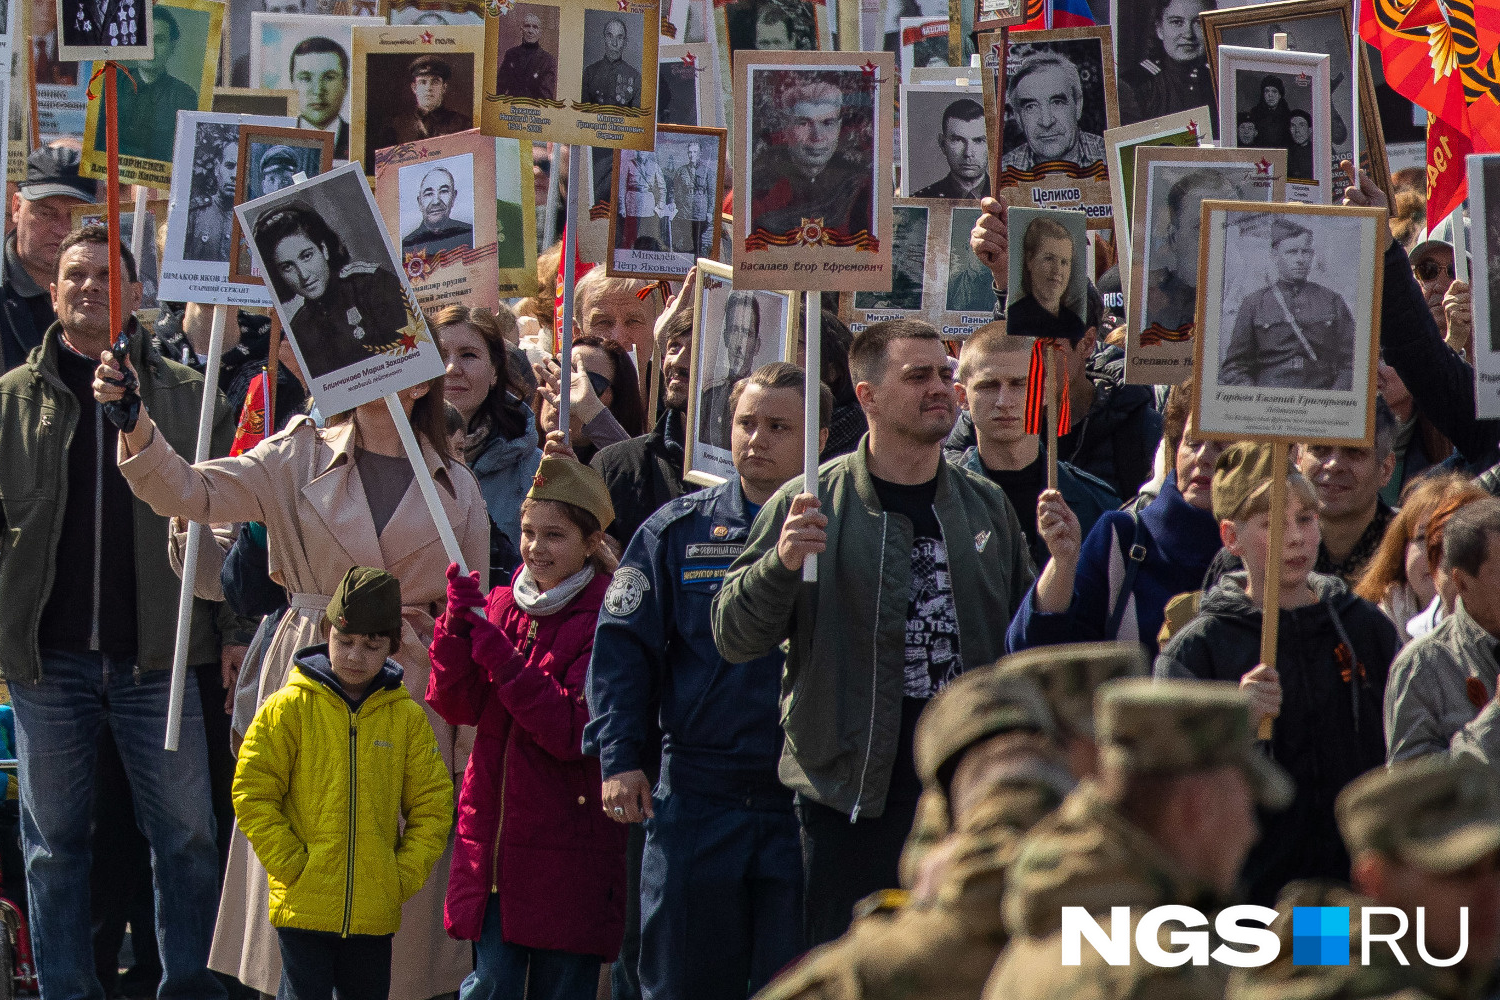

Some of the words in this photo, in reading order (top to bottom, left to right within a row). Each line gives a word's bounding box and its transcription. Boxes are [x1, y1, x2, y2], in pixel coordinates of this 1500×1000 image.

[1032, 187, 1080, 204] Целиков
[740, 261, 788, 271] Басалаев
[793, 261, 818, 273] Егор
[822, 261, 884, 273] Ефремович
[942, 325, 974, 335] Сергей
[1132, 357, 1179, 367] Степанов
[362, 363, 385, 378] Мария
